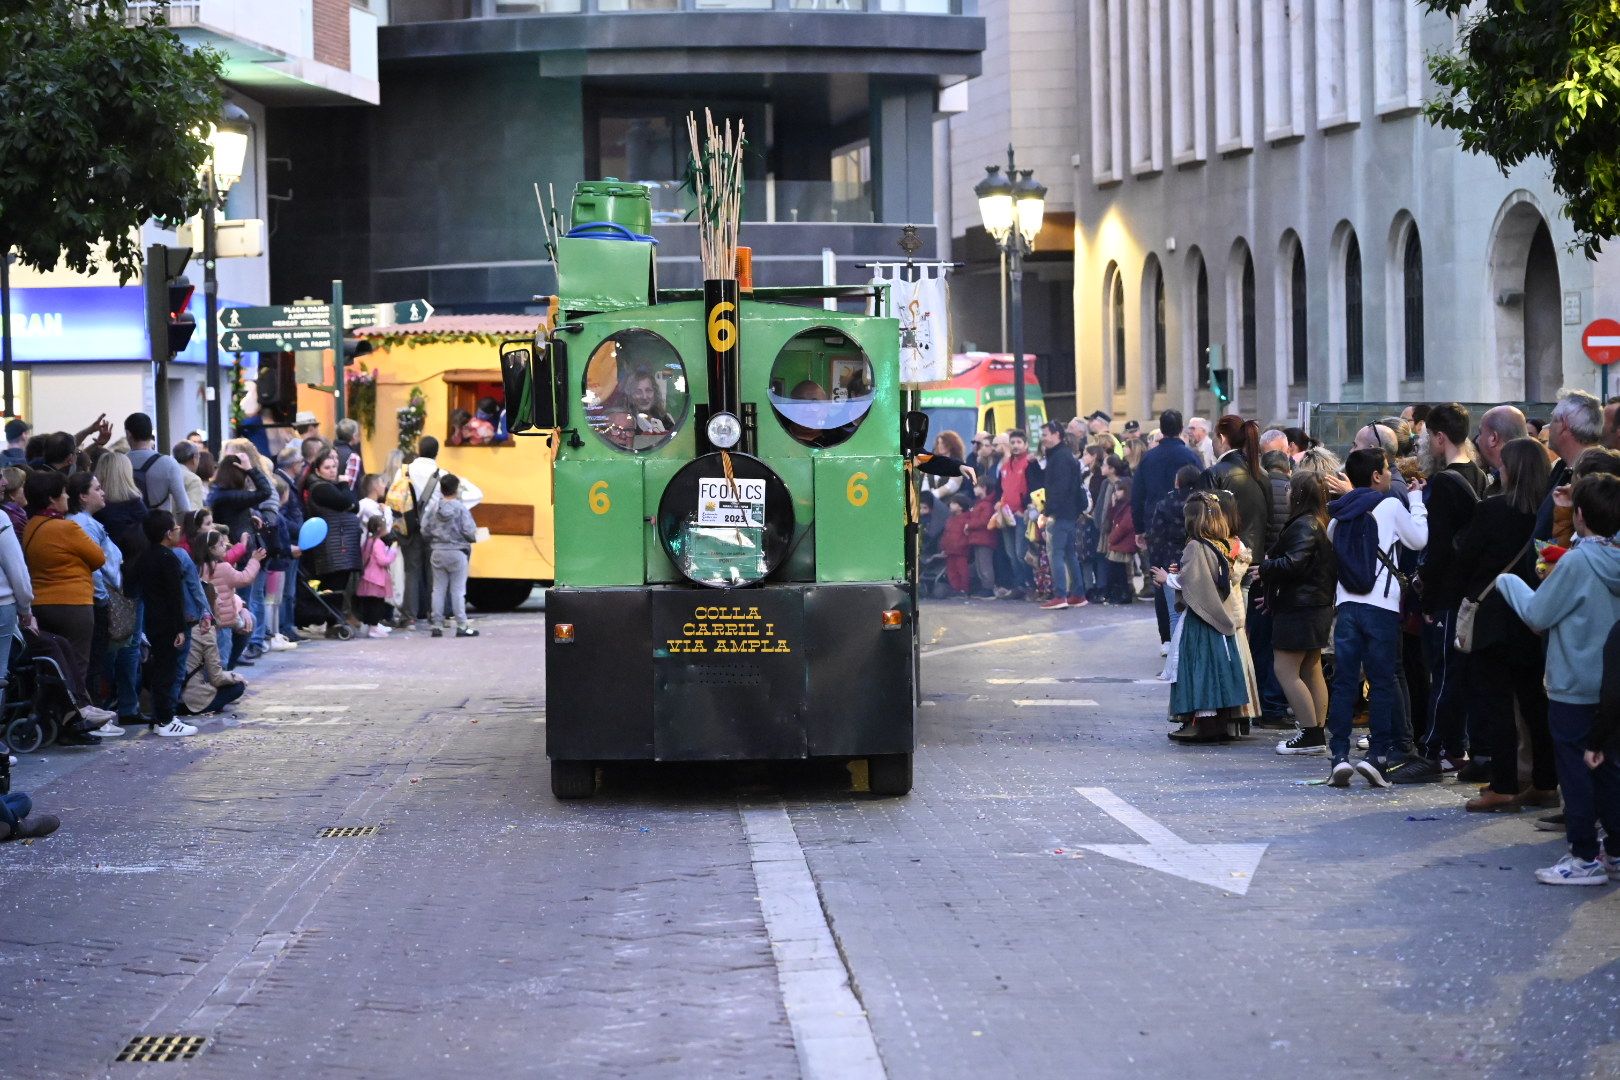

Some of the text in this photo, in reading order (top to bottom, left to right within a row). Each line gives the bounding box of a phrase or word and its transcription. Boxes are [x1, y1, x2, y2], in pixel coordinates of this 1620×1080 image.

[708, 301, 737, 352] 6
[847, 472, 869, 506] 6
[588, 481, 611, 515] 6
[724, 514, 746, 522] 2023
[694, 606, 762, 620] COLLA
[682, 623, 774, 636] CARRIL I
[666, 640, 791, 652] VIA AMPLA
